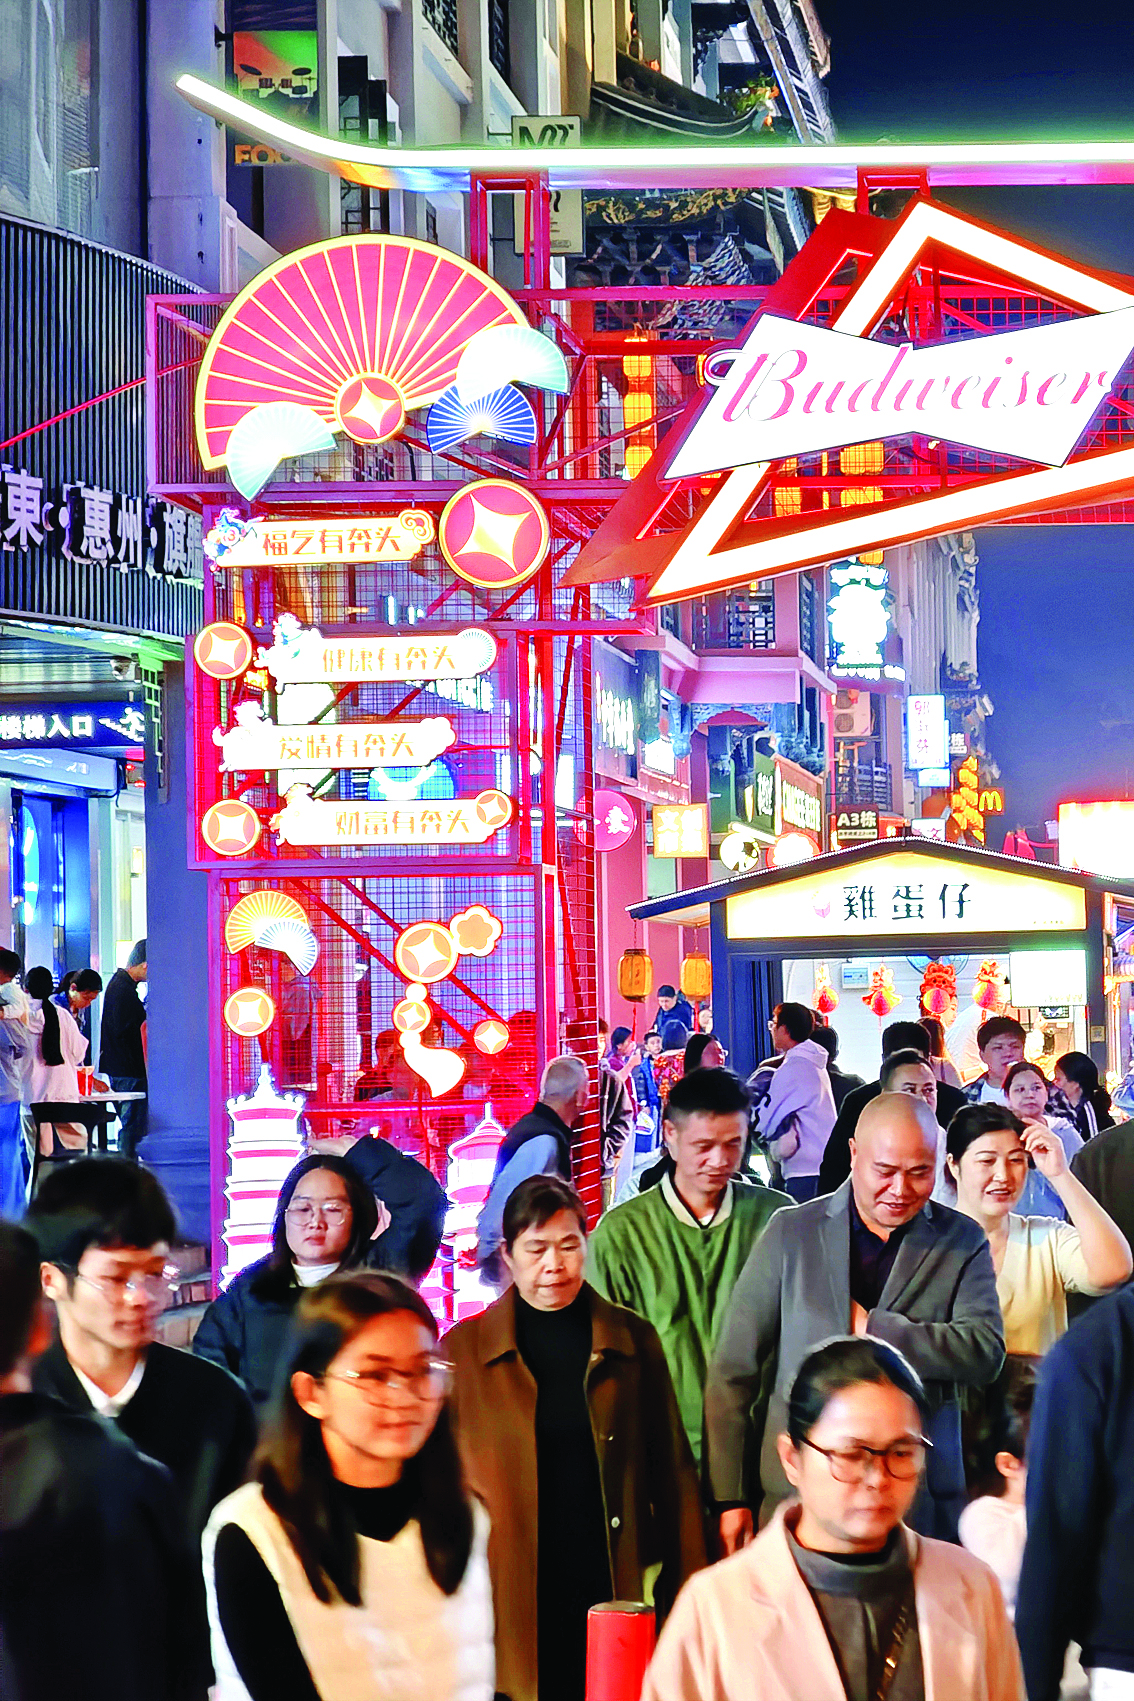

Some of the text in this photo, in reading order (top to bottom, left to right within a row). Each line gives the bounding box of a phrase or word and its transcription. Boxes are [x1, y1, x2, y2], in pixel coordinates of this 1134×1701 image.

[704, 342, 1111, 423] Budweiser
[262, 526, 401, 557] 福气有奔头
[323, 645, 456, 673] 健康有奔头
[279, 732, 415, 760] 爱情有奔头
[336, 809, 470, 836] 财富有奔头
[843, 882, 971, 921] 雞蛋仔
